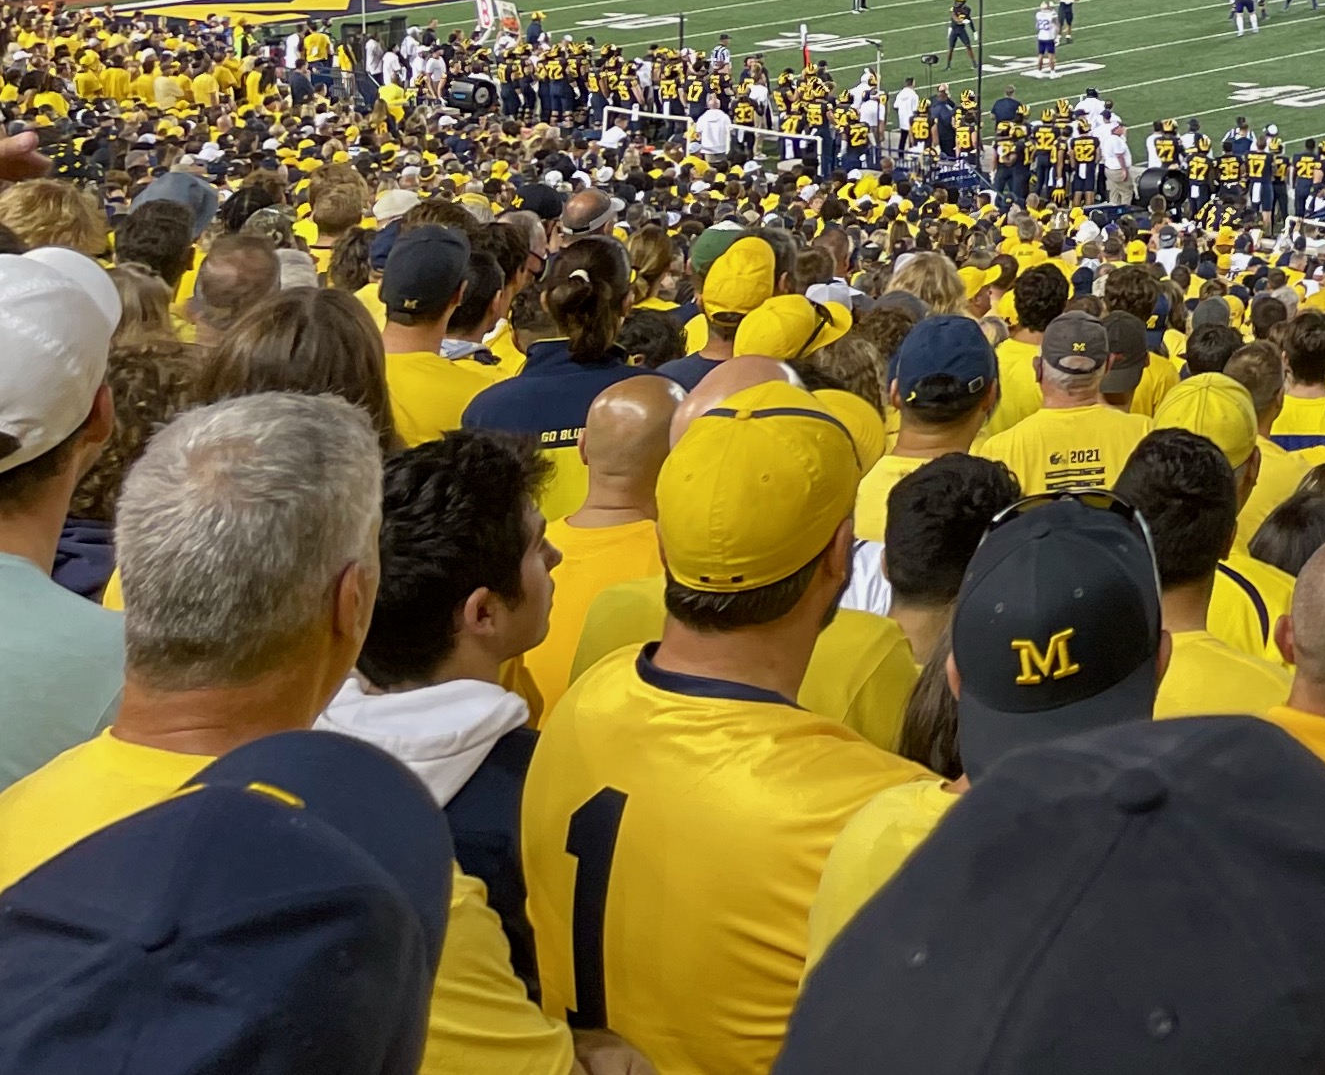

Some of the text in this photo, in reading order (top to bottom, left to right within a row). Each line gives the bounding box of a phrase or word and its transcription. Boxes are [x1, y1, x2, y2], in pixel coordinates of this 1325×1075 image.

[850, 125, 869, 147] 23
[1035, 130, 1056, 151] 32
[1073, 144, 1095, 163] 82
[1248, 158, 1265, 178] 17
[403, 298, 418, 310] M
[1072, 342, 1087, 352] M
[541, 431, 557, 442] GO
[1070, 449, 1101, 463] 2021
[1010, 628, 1079, 685] M
[564, 786, 630, 1029] 1
